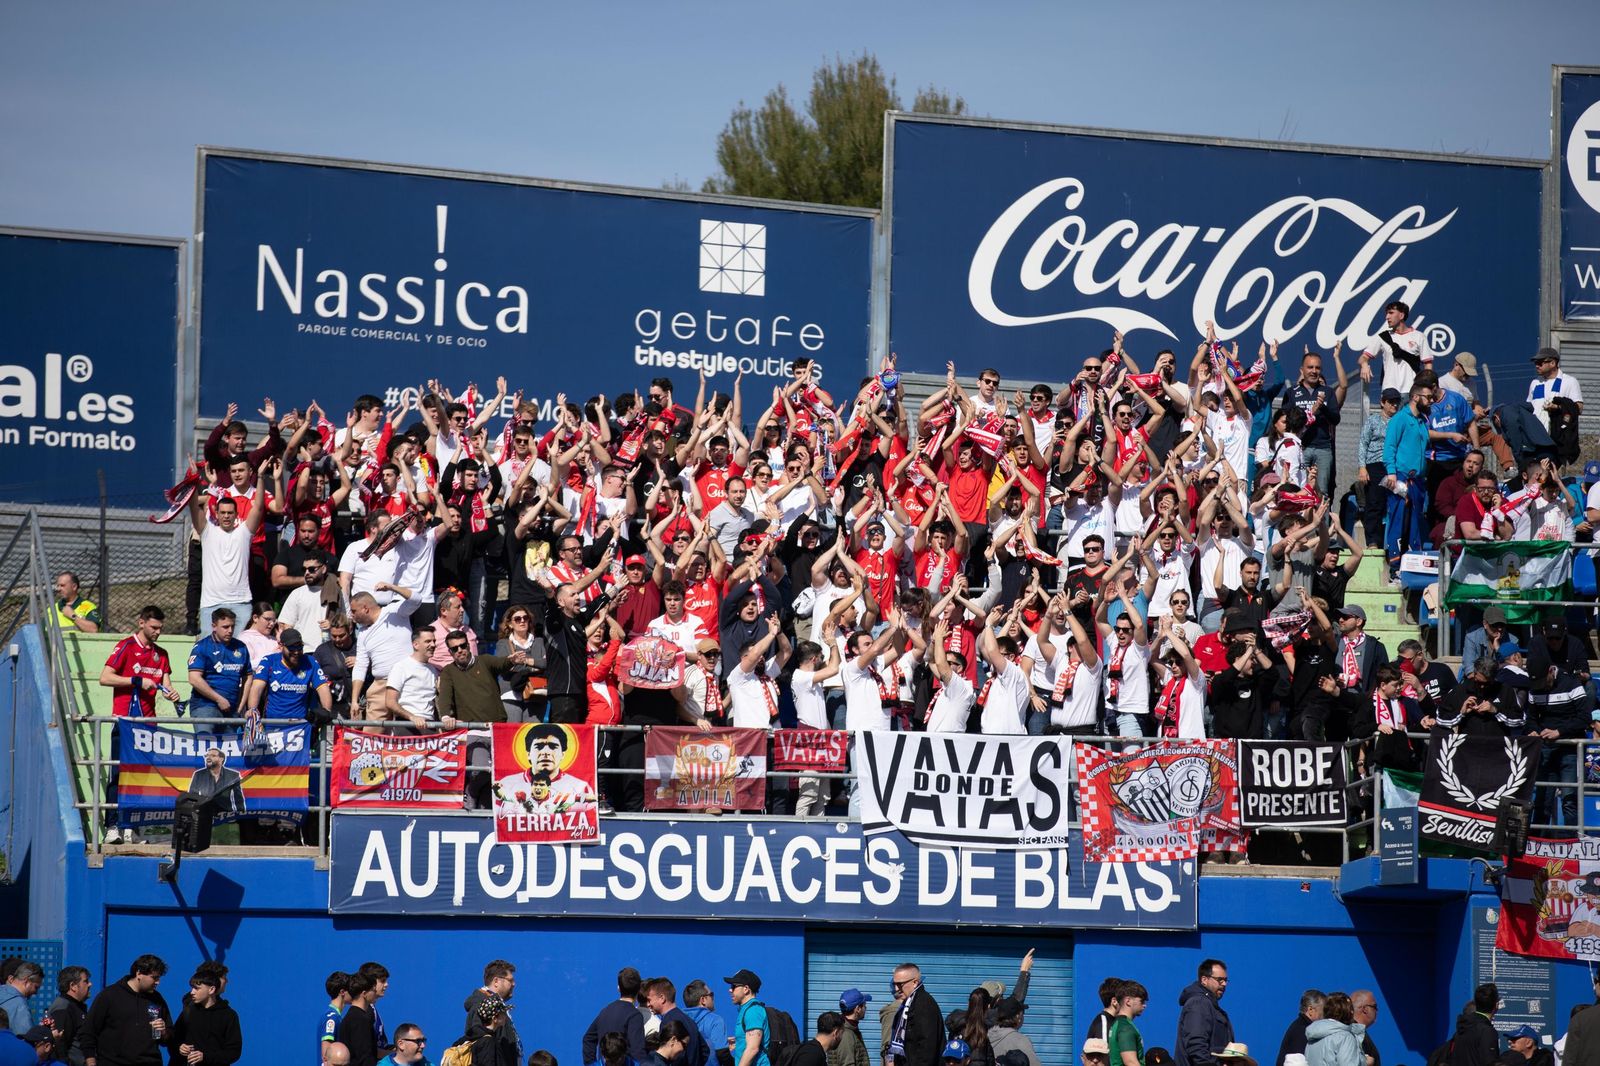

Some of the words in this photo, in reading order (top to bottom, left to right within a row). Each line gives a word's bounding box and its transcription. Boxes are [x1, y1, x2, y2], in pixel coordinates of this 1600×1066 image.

[257, 205, 528, 333] Nassica
[298, 323, 347, 336] PARQUE
[351, 327, 420, 342] COMERCIAL
[425, 334, 433, 344] Y
[437, 334, 453, 345] DE
[457, 336, 487, 348] OCIO
[635, 309, 825, 351] getafe
[634, 345, 823, 380] thestyleoutles
[29, 426, 136, 451] Formato
[350, 736, 459, 755] SANTIPONCE
[779, 731, 842, 761] VAYAS
[1252, 746, 1333, 787] ROBE
[863, 731, 1061, 832] VAYAS
[914, 771, 1012, 797] DONDE
[381, 788, 422, 802] 41970
[678, 785, 733, 806] ÁVILA
[1247, 791, 1340, 817] PRESENTE
[505, 811, 589, 832] TERRAZA
[1017, 836, 1038, 846] SFC
[1040, 836, 1066, 846] FANS
[1169, 834, 1187, 845] ON
[351, 829, 901, 906] AUTODESGUACES
[918, 846, 998, 909] DE
